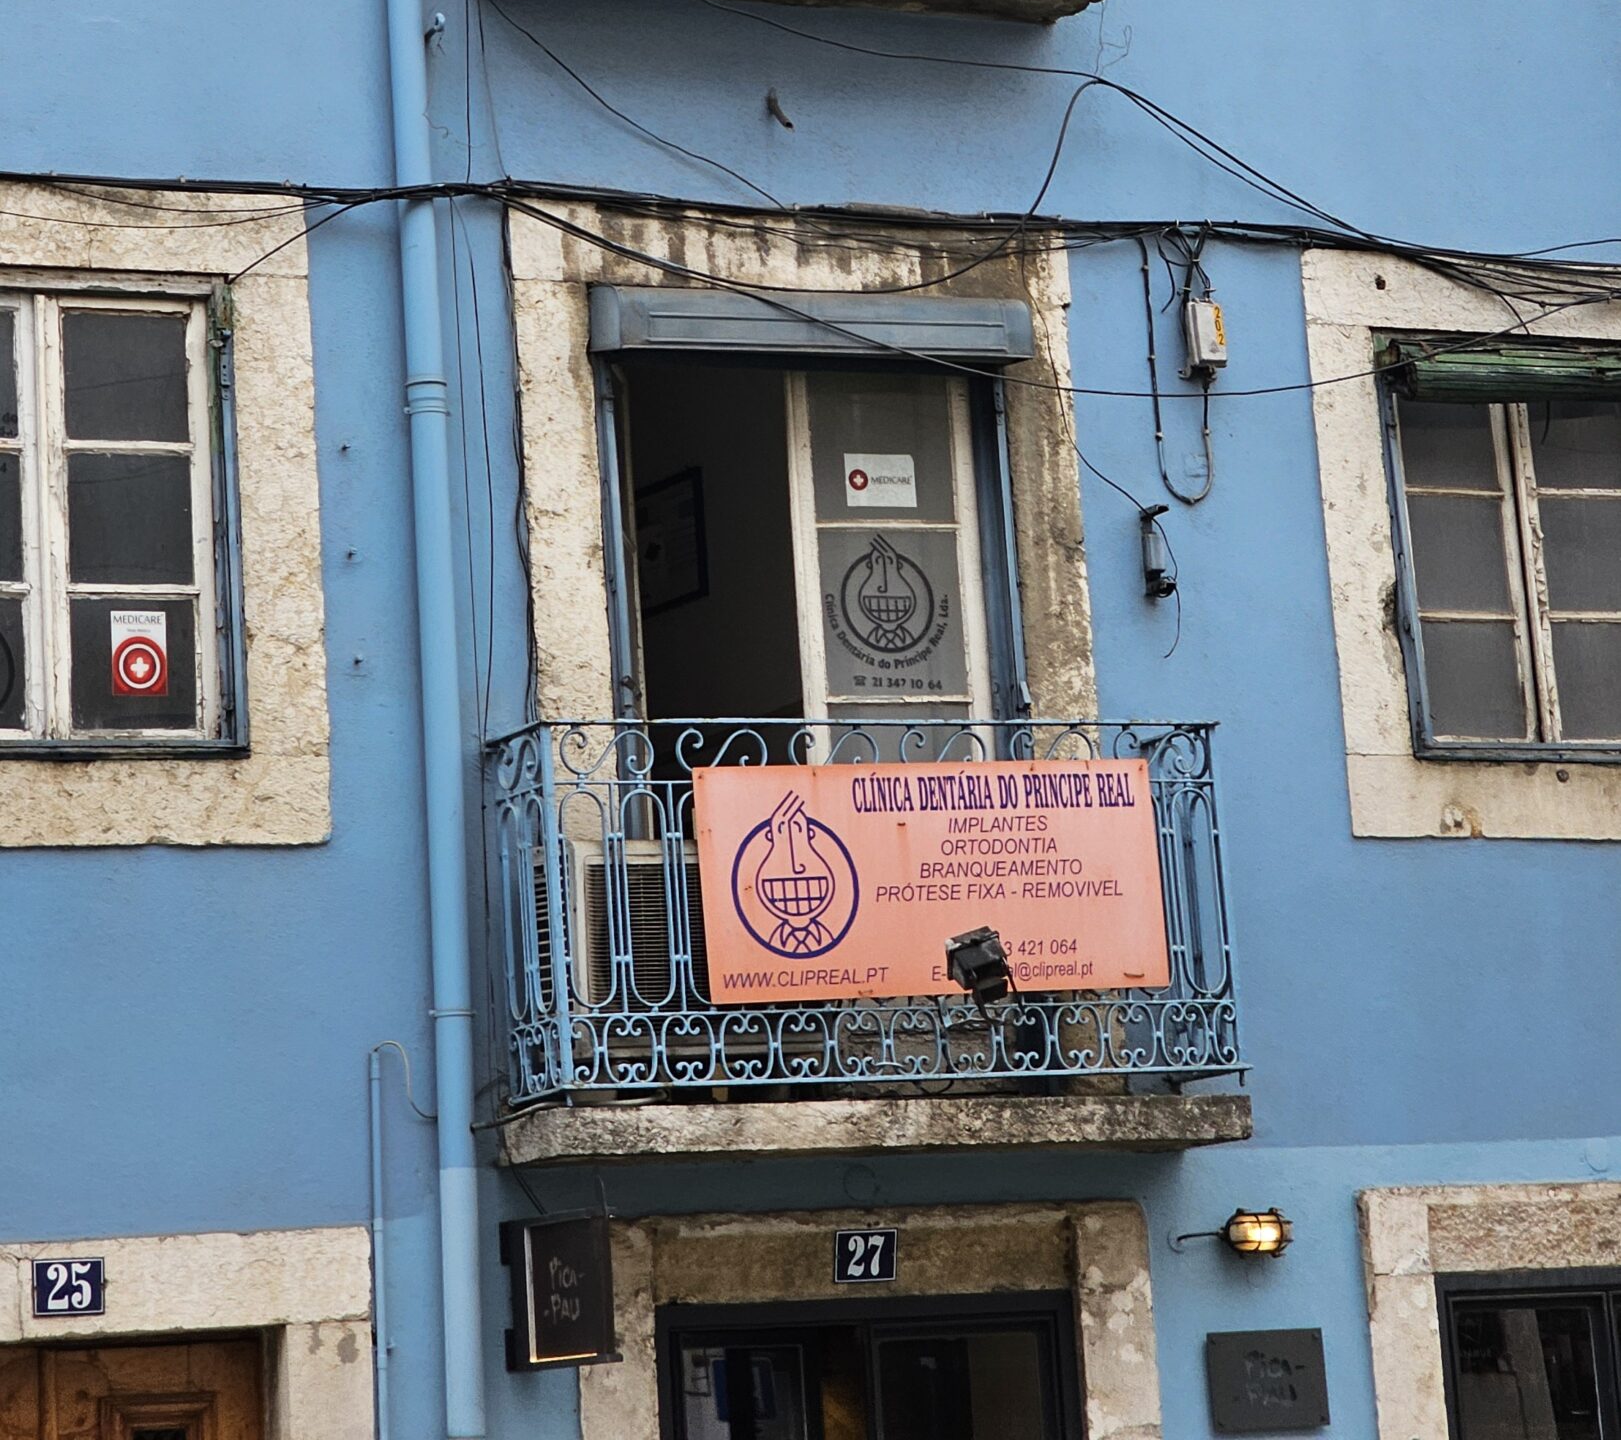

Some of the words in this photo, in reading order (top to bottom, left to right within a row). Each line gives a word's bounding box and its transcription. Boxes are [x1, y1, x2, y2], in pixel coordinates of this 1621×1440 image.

[1214, 306, 1225, 346] 202
[870, 475, 911, 486] MEDICARE
[112, 614, 163, 625] MEDICARE
[836, 630, 876, 666] Dentária
[878, 658, 891, 669] do
[872, 677, 882, 688] 21
[887, 677, 907, 688] 347
[911, 678, 923, 689] 10
[928, 679, 943, 690] 64
[852, 771, 914, 813] CLÍNICA
[918, 770, 995, 812] DENTÁRIA
[997, 773, 1019, 809] DO
[1023, 773, 1093, 809] PRINCIPE
[1096, 772, 1136, 808] REAL
[948, 815, 1048, 834] IMPLANTES
[940, 837, 1058, 856] ORTODONTIA
[920, 859, 1083, 879] BRANQUEAMENTO
[876, 882, 961, 903] PRÓTESE
[967, 882, 1006, 900] FIXA
[1022, 879, 1124, 899] REMOVIVEL
[1018, 939, 1044, 956] 421
[1050, 938, 1078, 955] 064
[723, 966, 889, 989] WWW.CLIPREAL.PT
[847, 1235, 885, 1277] 27
[47, 1263, 92, 1310] 25
